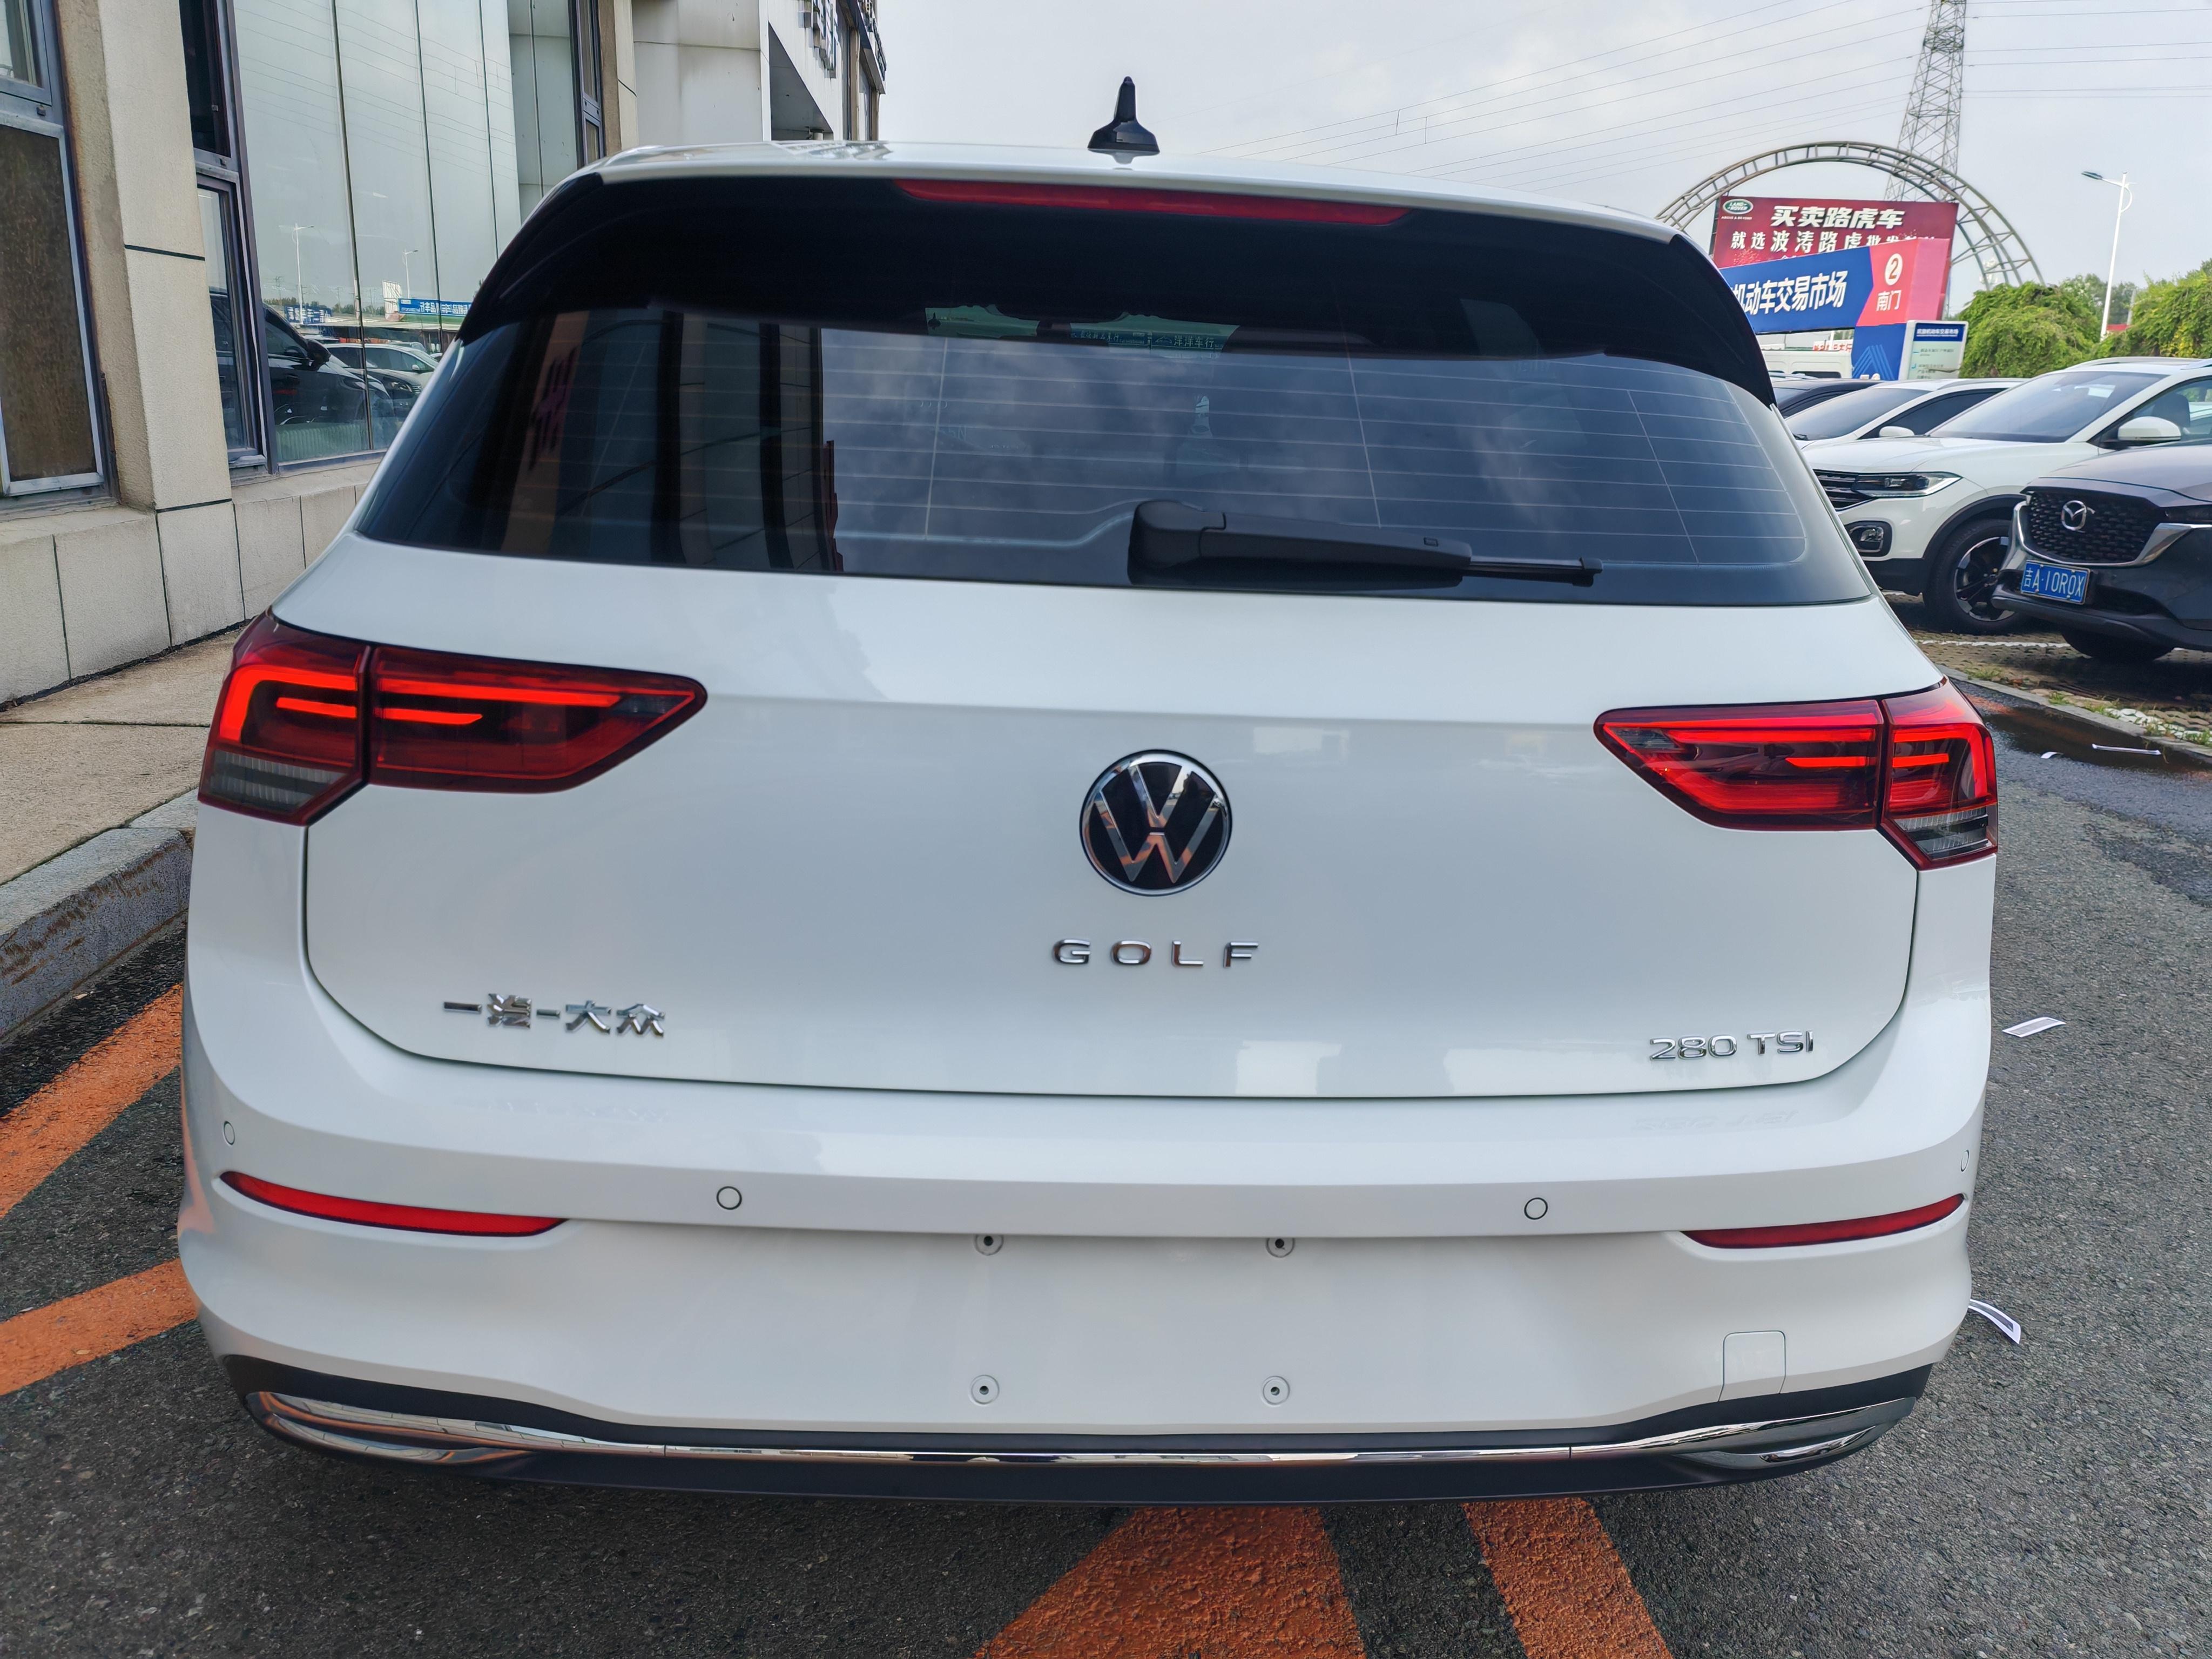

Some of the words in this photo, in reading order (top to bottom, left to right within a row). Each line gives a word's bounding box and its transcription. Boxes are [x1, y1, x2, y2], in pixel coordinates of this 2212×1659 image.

[1770, 205, 1905, 229] 买卖路虎车
[1889, 258, 1899, 279] 2
[1732, 270, 1849, 315] 机动车交易市场
[1876, 289, 1902, 311] 南门
[1052, 939, 1259, 968] GOLF
[443, 993, 665, 1037] 一汽-大众
[1649, 1034, 1737, 1061] 280
[1746, 1030, 1814, 1055] TSI
